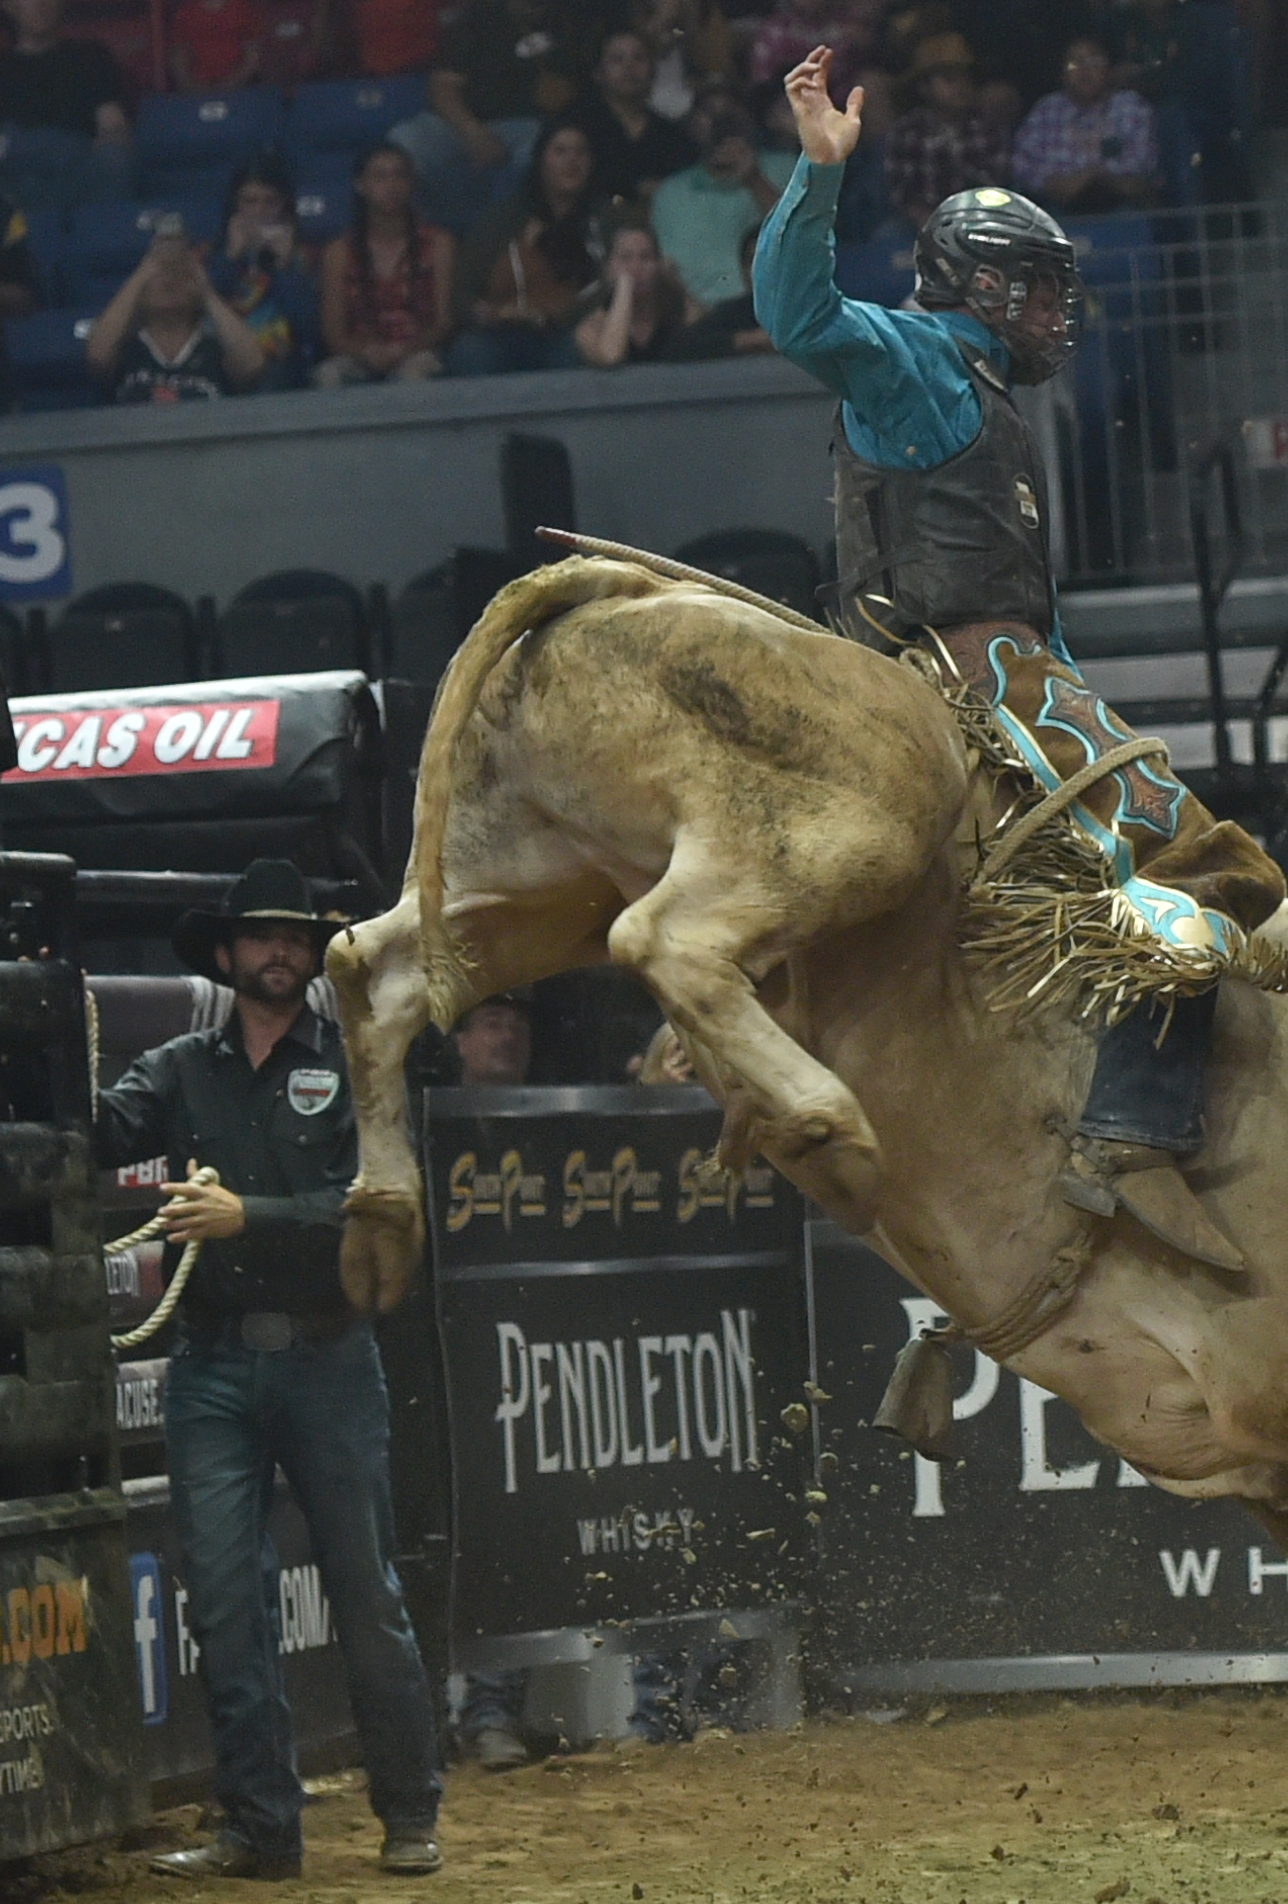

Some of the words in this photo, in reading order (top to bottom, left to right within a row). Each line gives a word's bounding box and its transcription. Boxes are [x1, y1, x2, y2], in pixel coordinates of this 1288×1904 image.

[153, 709, 254, 764] OIL
[495, 1308, 758, 1493] PENDLETON
[577, 1508, 695, 1556] WHISKY
